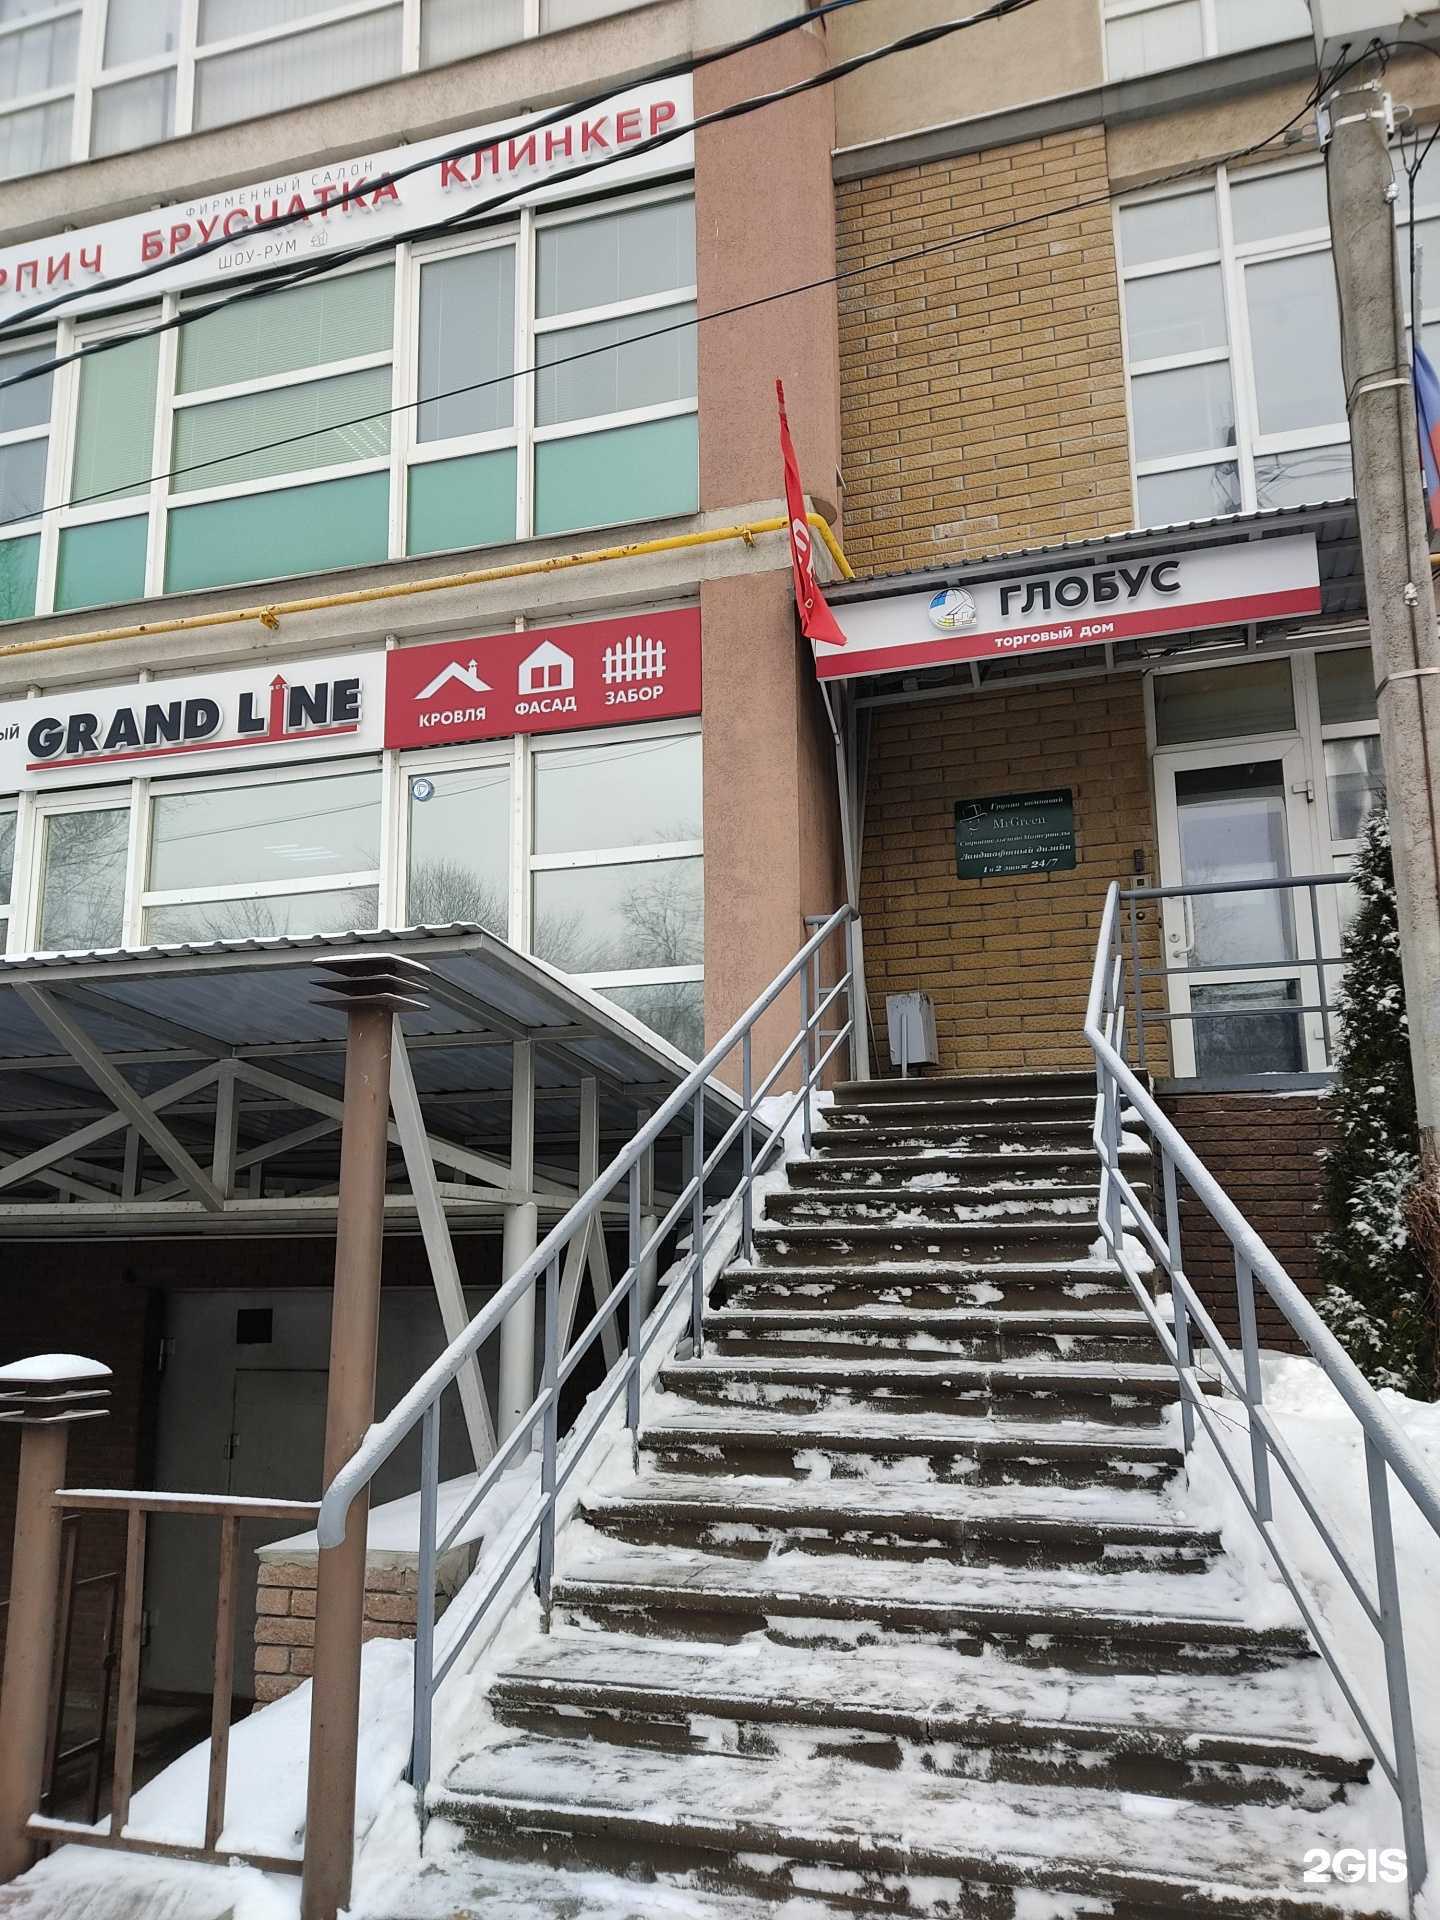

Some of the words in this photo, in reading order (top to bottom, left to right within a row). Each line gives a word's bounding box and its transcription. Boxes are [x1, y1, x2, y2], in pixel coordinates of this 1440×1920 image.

[440, 101, 677, 188] КЛИНКЕР
[186, 176, 300, 217] ФИРМЕННЫЙ
[311, 160, 374, 186] САЛОН
[218, 239, 297, 270] ШОУ-РУМ
[1000, 560, 1182, 616] ГЛОБУС
[994, 626, 1073, 649] торговый
[1080, 622, 1115, 638] дом
[515, 696, 577, 716] ФАСАД
[605, 685, 664, 705] ЗАБОР
[28, 697, 221, 758] GRAND
[237, 674, 360, 737] LINE
[419, 707, 487, 727] КРОВЛЯ
[1030, 858, 1058, 869] 24/7
